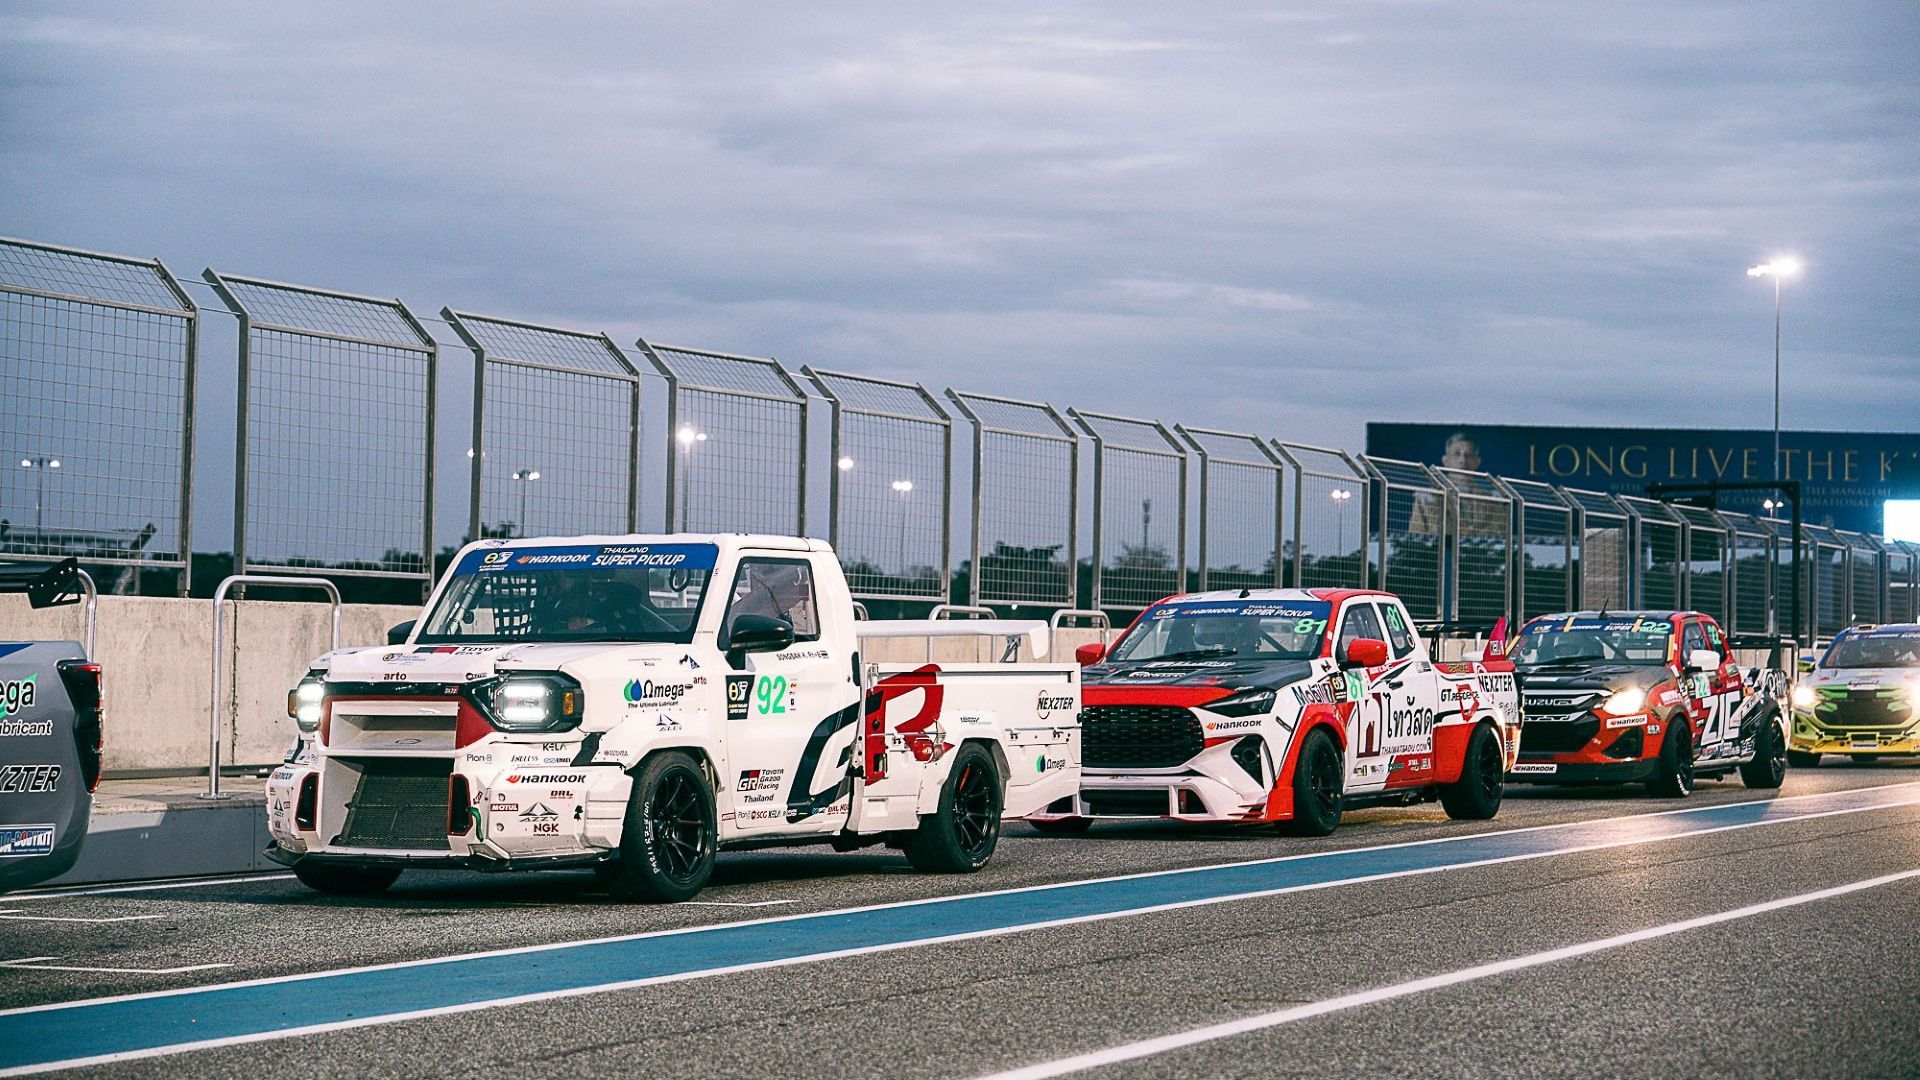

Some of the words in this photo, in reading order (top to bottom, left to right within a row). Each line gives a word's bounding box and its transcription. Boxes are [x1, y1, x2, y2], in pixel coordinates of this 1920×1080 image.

[1528, 444, 1648, 478] LONG
[1669, 447, 1759, 480] LIVE
[1777, 449, 1859, 482] THE
[592, 554, 638, 566] SUPER
[635, 554, 686, 566] PICKUP
[1240, 608, 1275, 616] SUPER
[1273, 609, 1313, 617] PICKUP
[1293, 618, 1328, 635] 81
[383, 671, 407, 681] arto
[1477, 674, 1513, 693] NEXZTER
[757, 675, 787, 715] 92
[1036, 696, 1074, 710] NEXZTER
[744, 794, 775, 803] Thailand
[533, 823, 559, 832] NGK
